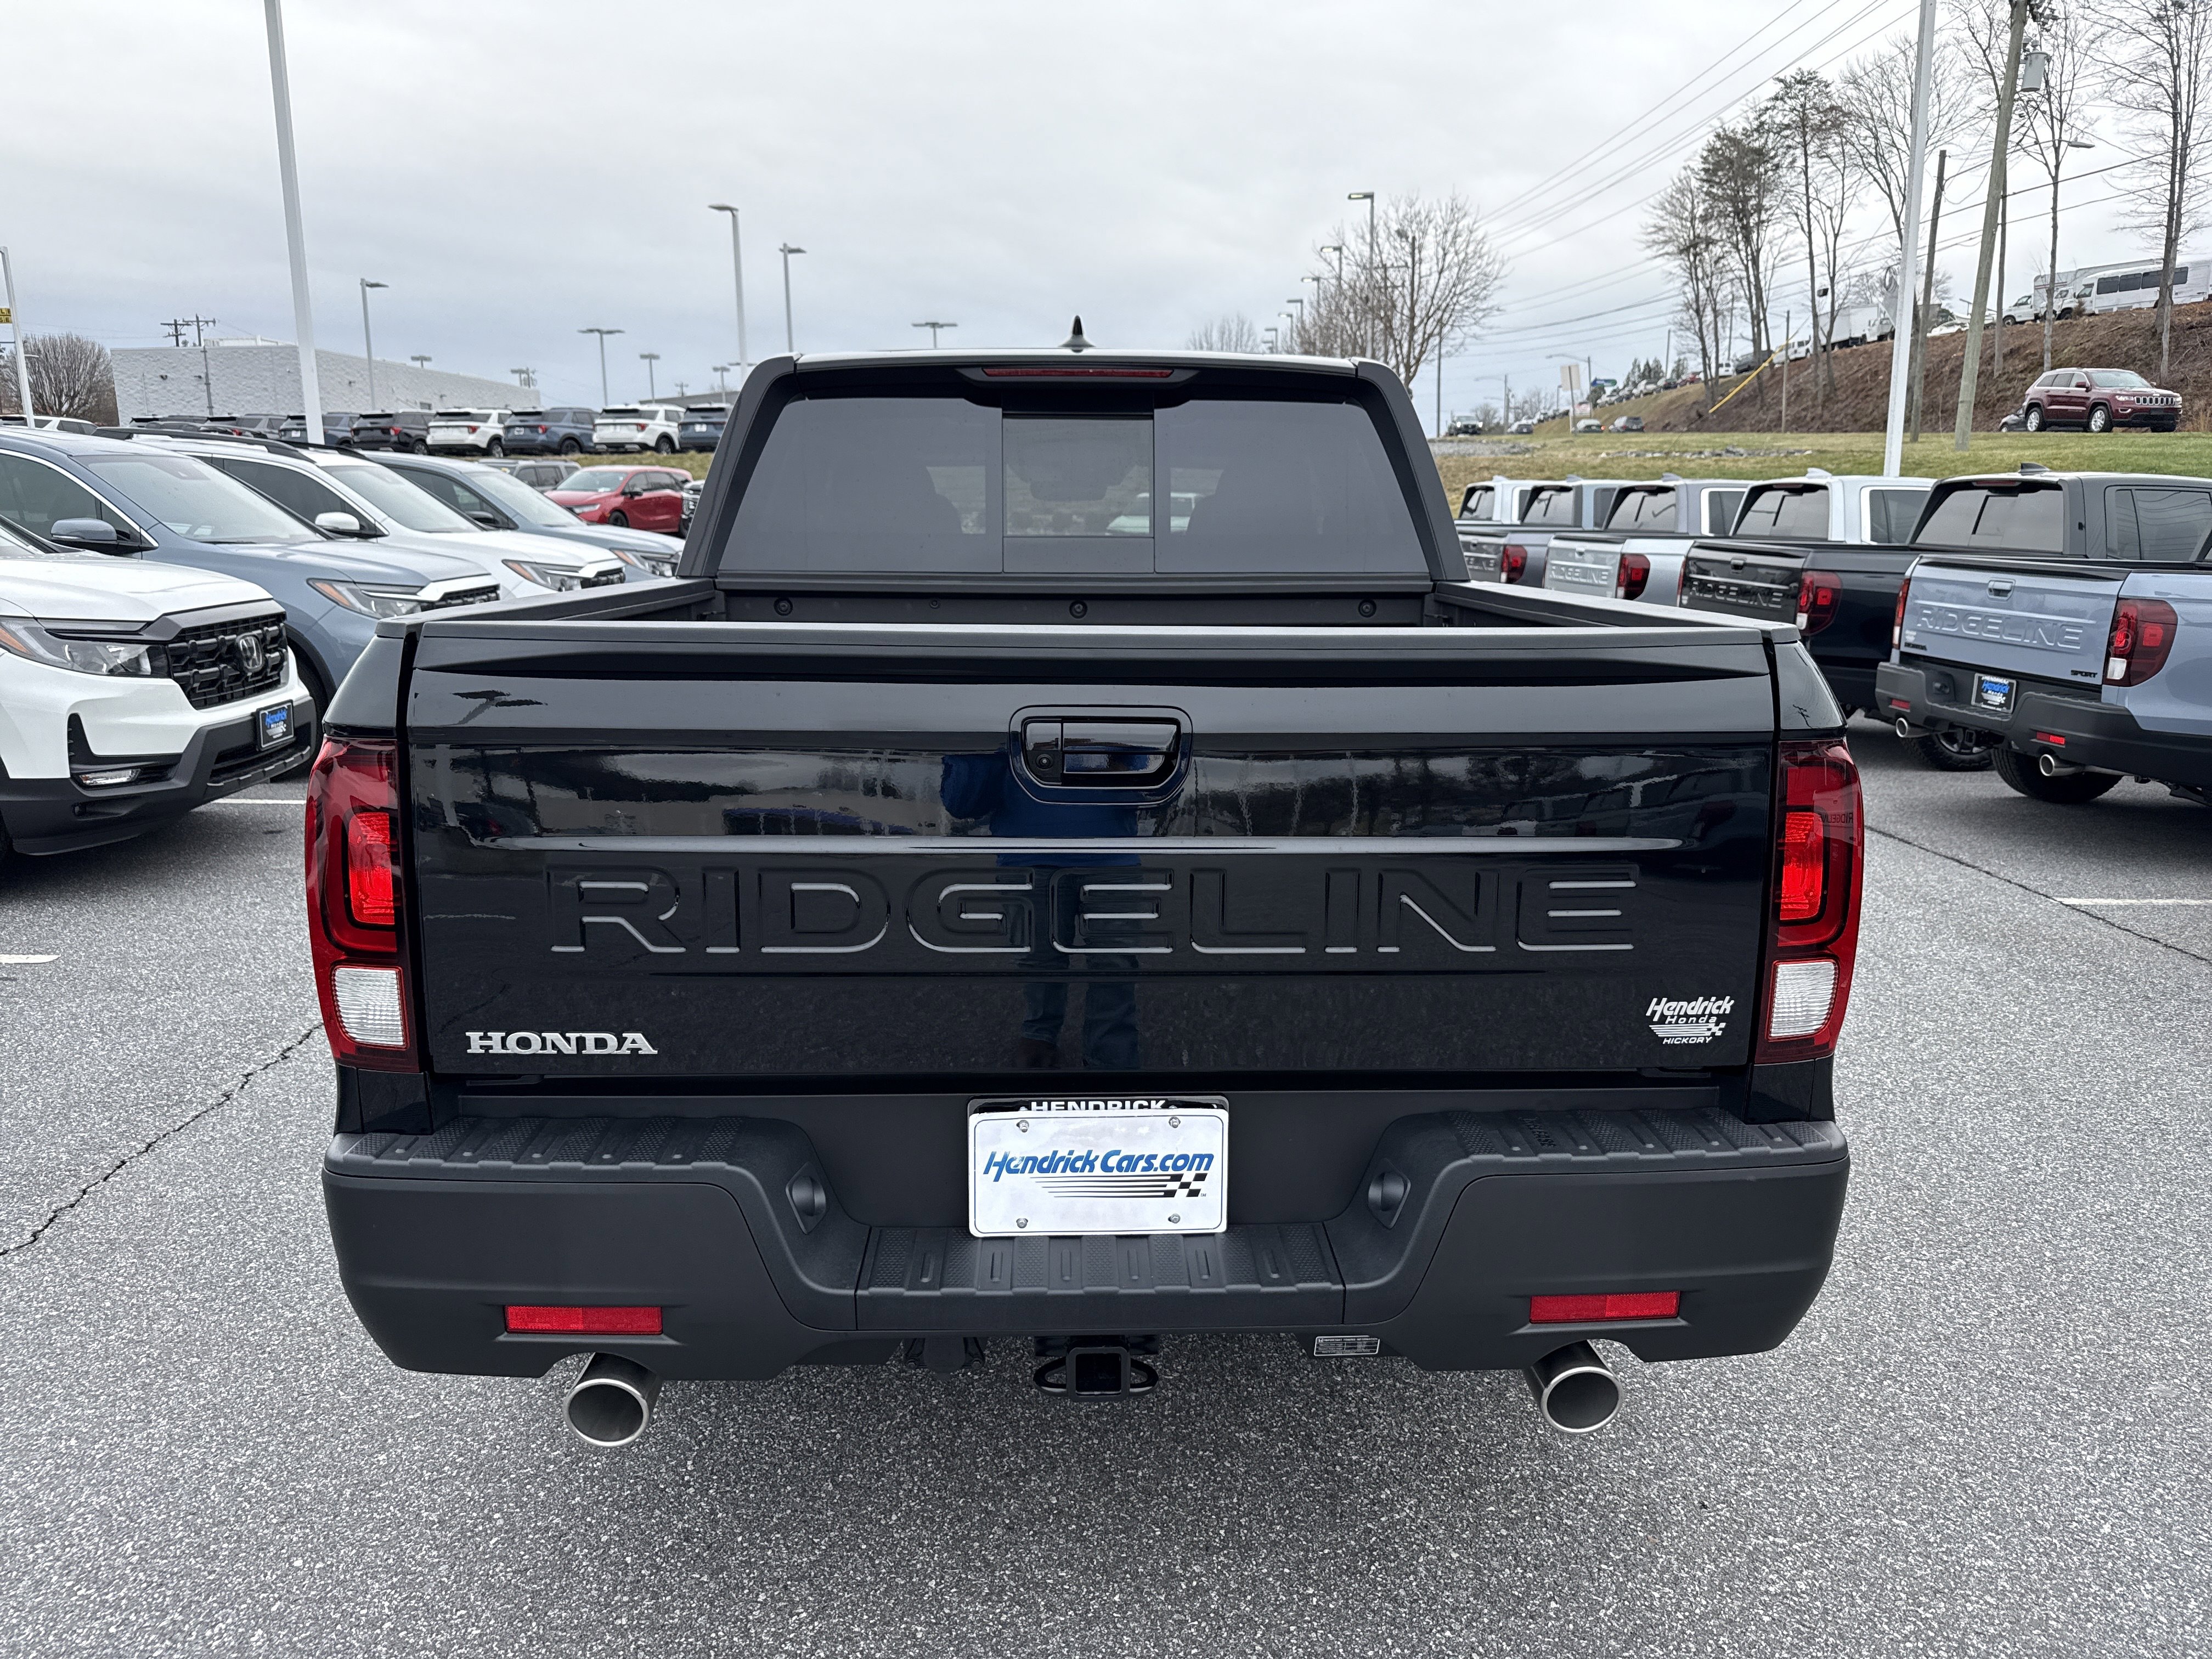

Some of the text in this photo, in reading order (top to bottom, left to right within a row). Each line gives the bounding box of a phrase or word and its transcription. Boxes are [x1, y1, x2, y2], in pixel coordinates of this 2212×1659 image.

[1689, 580, 1784, 608] RIDGELINE
[1916, 606, 2084, 650] RIDGELINE
[548, 865, 1638, 954] RIDGELINE
[1646, 996, 1735, 1022] Hendrick
[1664, 1014, 1717, 1024] Honda
[465, 1031, 658, 1055] HONDA
[1662, 1036, 1713, 1045] HICKORY
[1031, 1100, 1166, 1111] HENDRICK
